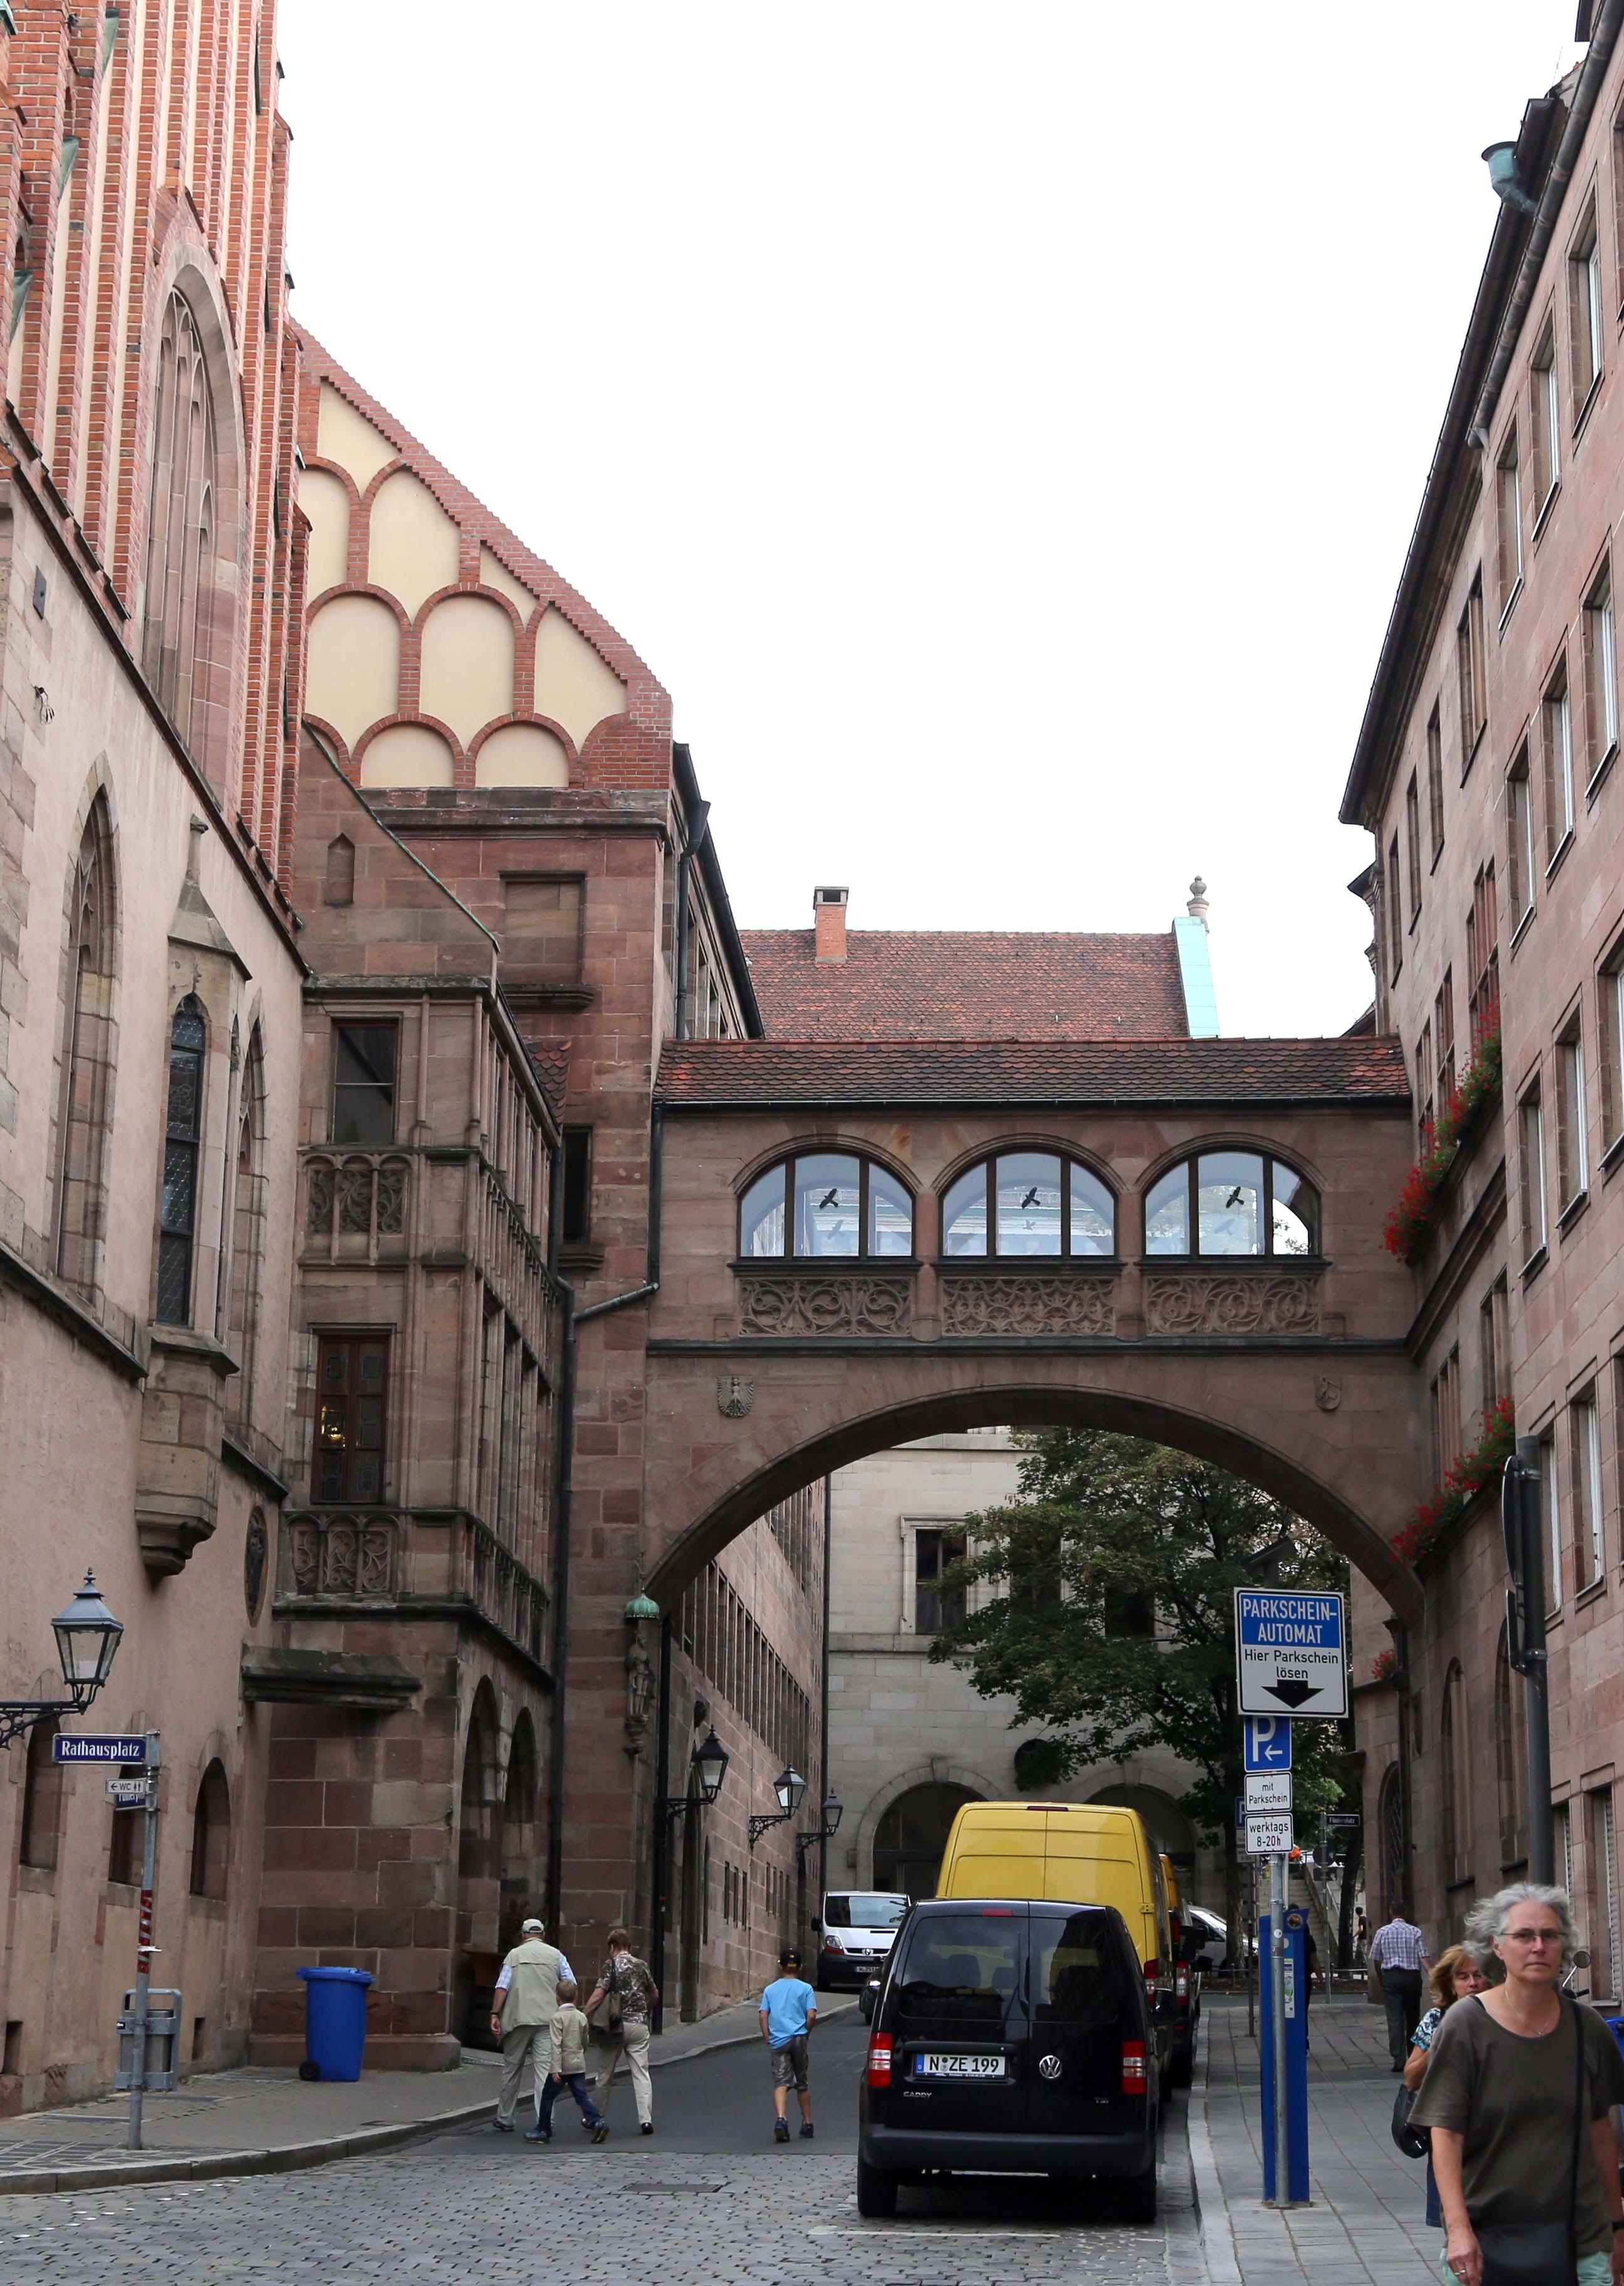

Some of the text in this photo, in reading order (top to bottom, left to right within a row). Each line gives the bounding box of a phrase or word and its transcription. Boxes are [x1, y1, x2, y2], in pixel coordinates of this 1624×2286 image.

[1243, 1598, 1337, 1621] PARKSCHEIN-
[1257, 1622, 1323, 1644] AUTOMAT
[1244, 1649, 1338, 1664] Hier Parkschein
[1276, 1666, 1308, 1679] lösen
[1252, 1715, 1276, 1762] P
[62, 1740, 140, 1760] Rathausplatz
[1262, 1782, 1274, 1792] mit
[1249, 1793, 1288, 1805] Parkschein
[1249, 1822, 1289, 1834] werktags
[972, 2057, 999, 2073] 199
